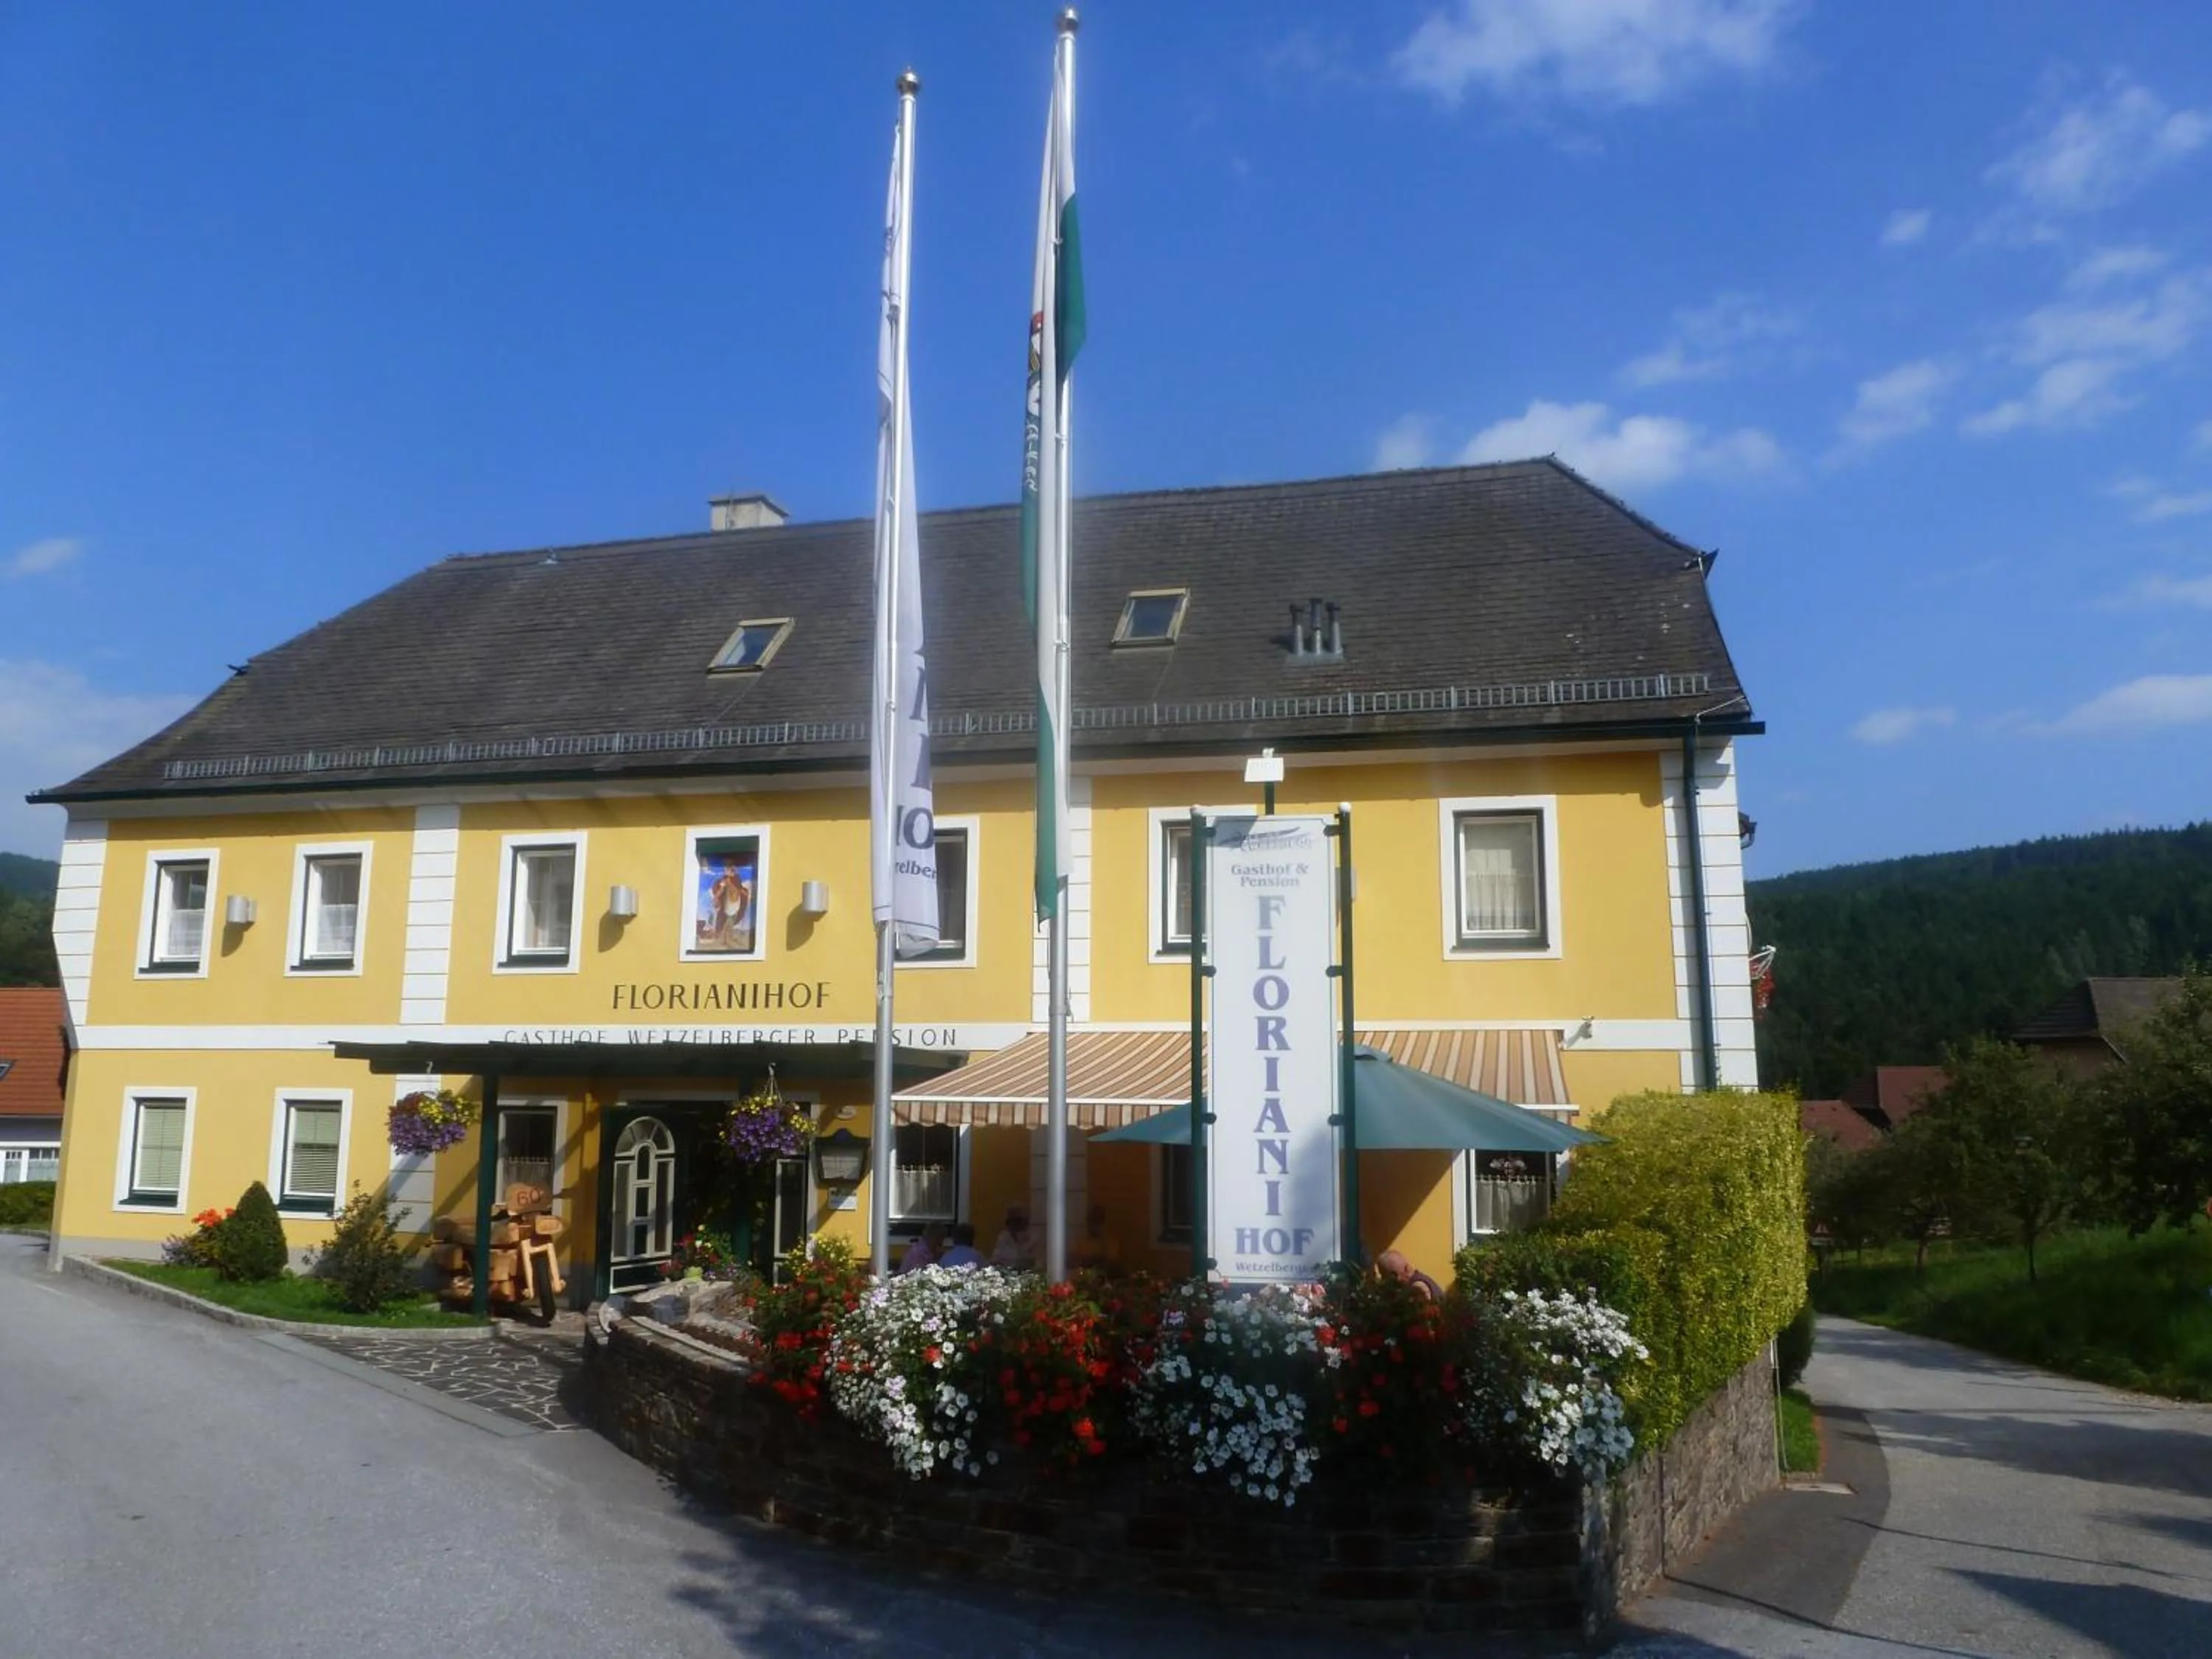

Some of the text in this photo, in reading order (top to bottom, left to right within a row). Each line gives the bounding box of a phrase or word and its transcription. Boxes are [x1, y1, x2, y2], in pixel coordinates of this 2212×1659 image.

[1231, 863, 1309, 875] Gasthof &
[1240, 876, 1300, 887] Pension
[613, 981, 832, 1009] FLORIANIHOF
[838, 1029, 956, 1046] PESION
[1235, 1228, 1314, 1255] HOF
